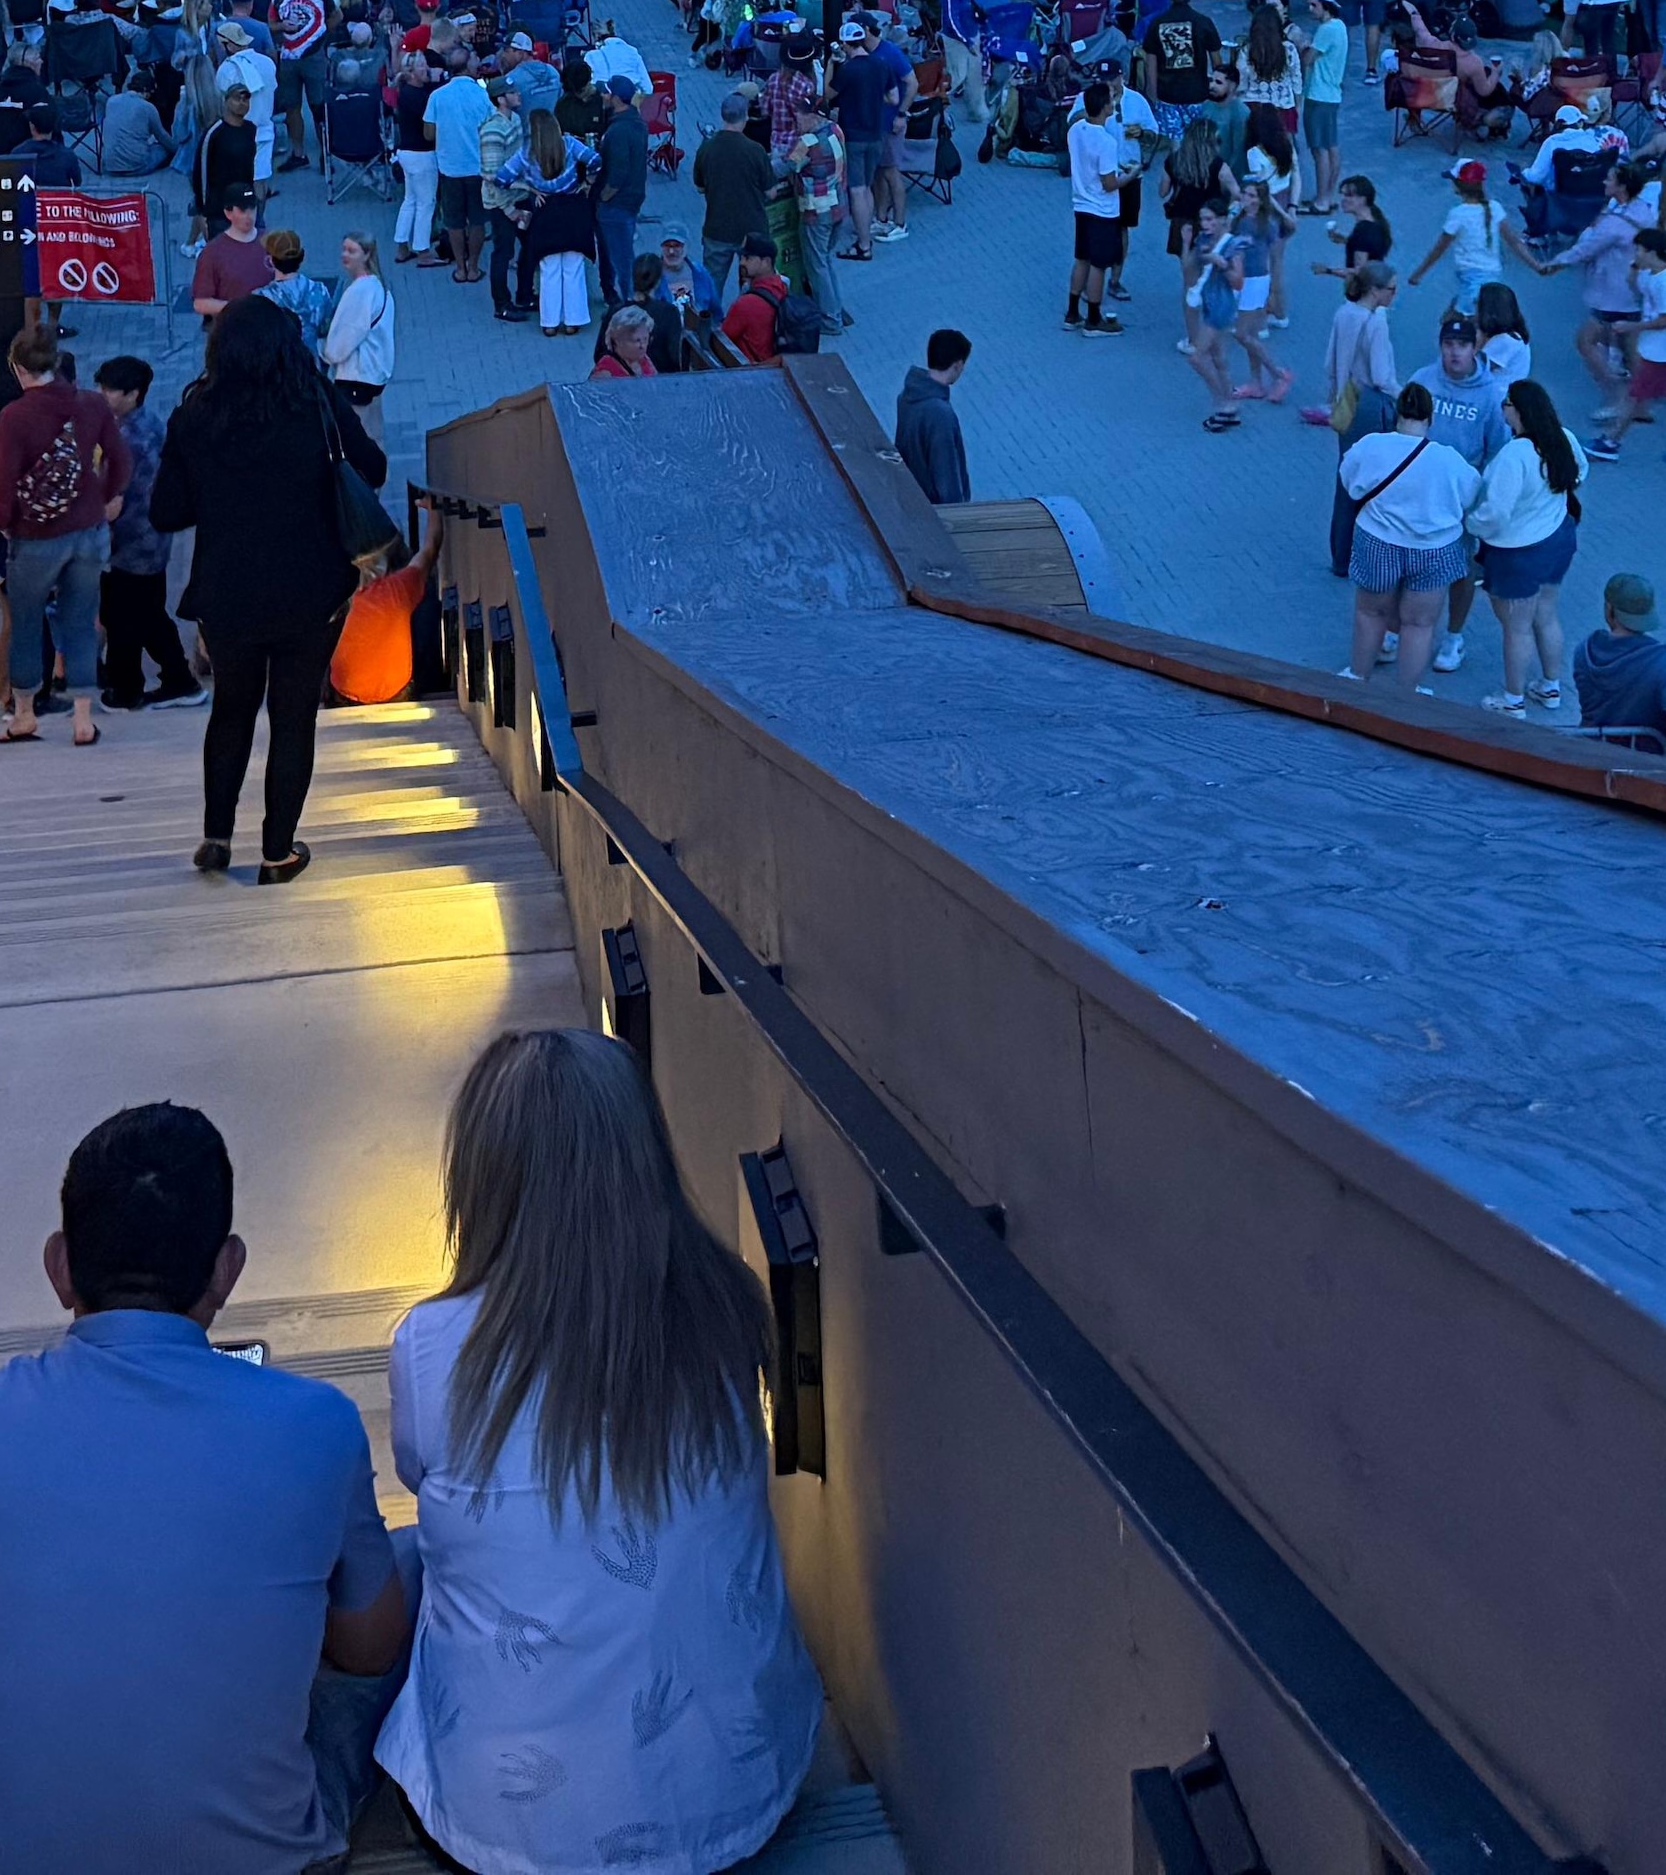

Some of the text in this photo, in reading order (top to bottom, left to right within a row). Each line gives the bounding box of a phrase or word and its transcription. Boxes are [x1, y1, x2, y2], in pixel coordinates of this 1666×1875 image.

[45, 205, 60, 218] TO
[63, 205, 82, 218] THE
[46, 231, 66, 242] AND
[1433, 398, 1479, 422] INES
